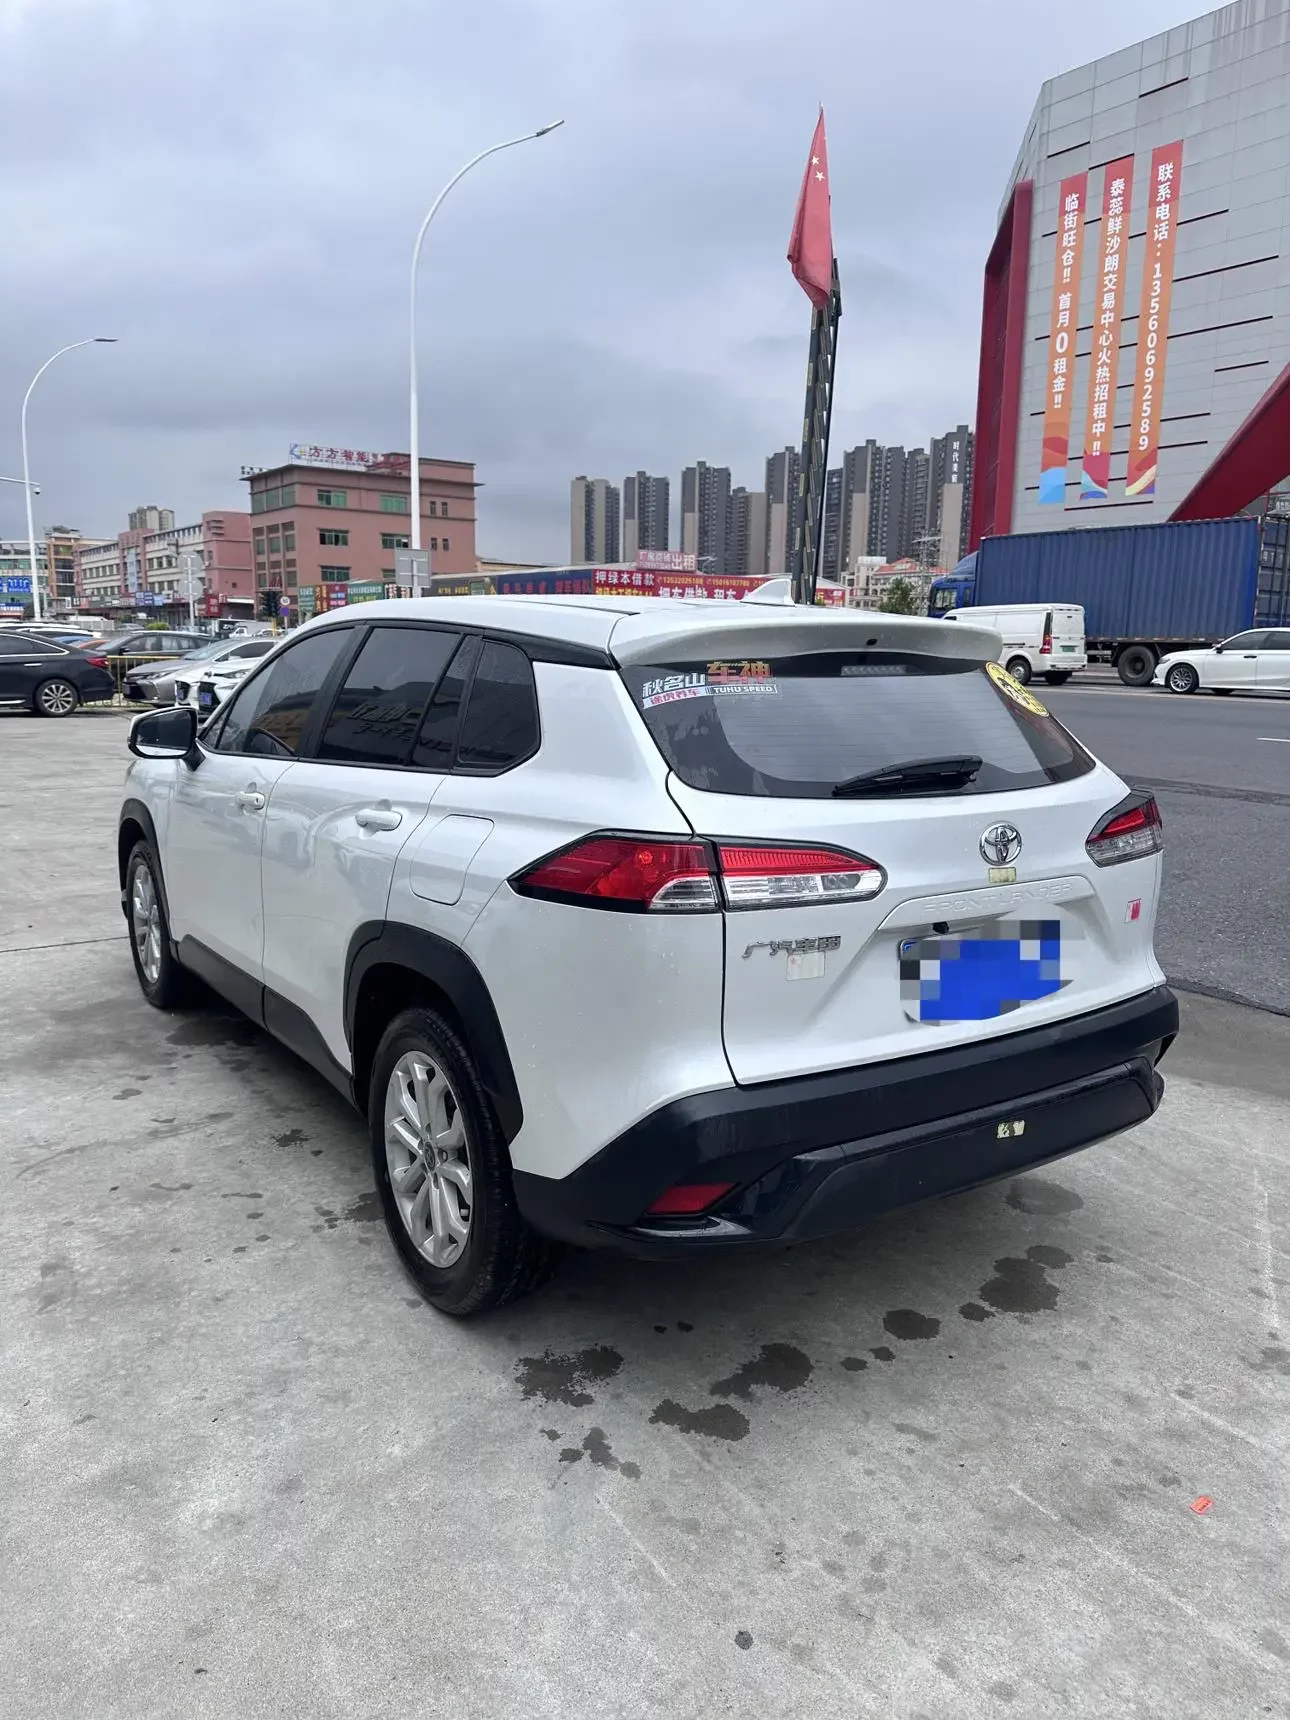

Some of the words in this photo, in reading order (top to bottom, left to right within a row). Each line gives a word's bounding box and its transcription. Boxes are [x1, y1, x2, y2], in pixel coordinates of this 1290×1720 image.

[672, 553, 696, 571] 出租
[595, 570, 655, 587] 押绿本借款
[642, 672, 706, 698] 秋名山
[707, 660, 772, 685] 车神
[650, 688, 702, 705] 途虎养车
[714, 685, 742, 694] TUHU
[743, 685, 773, 694] SPEED
